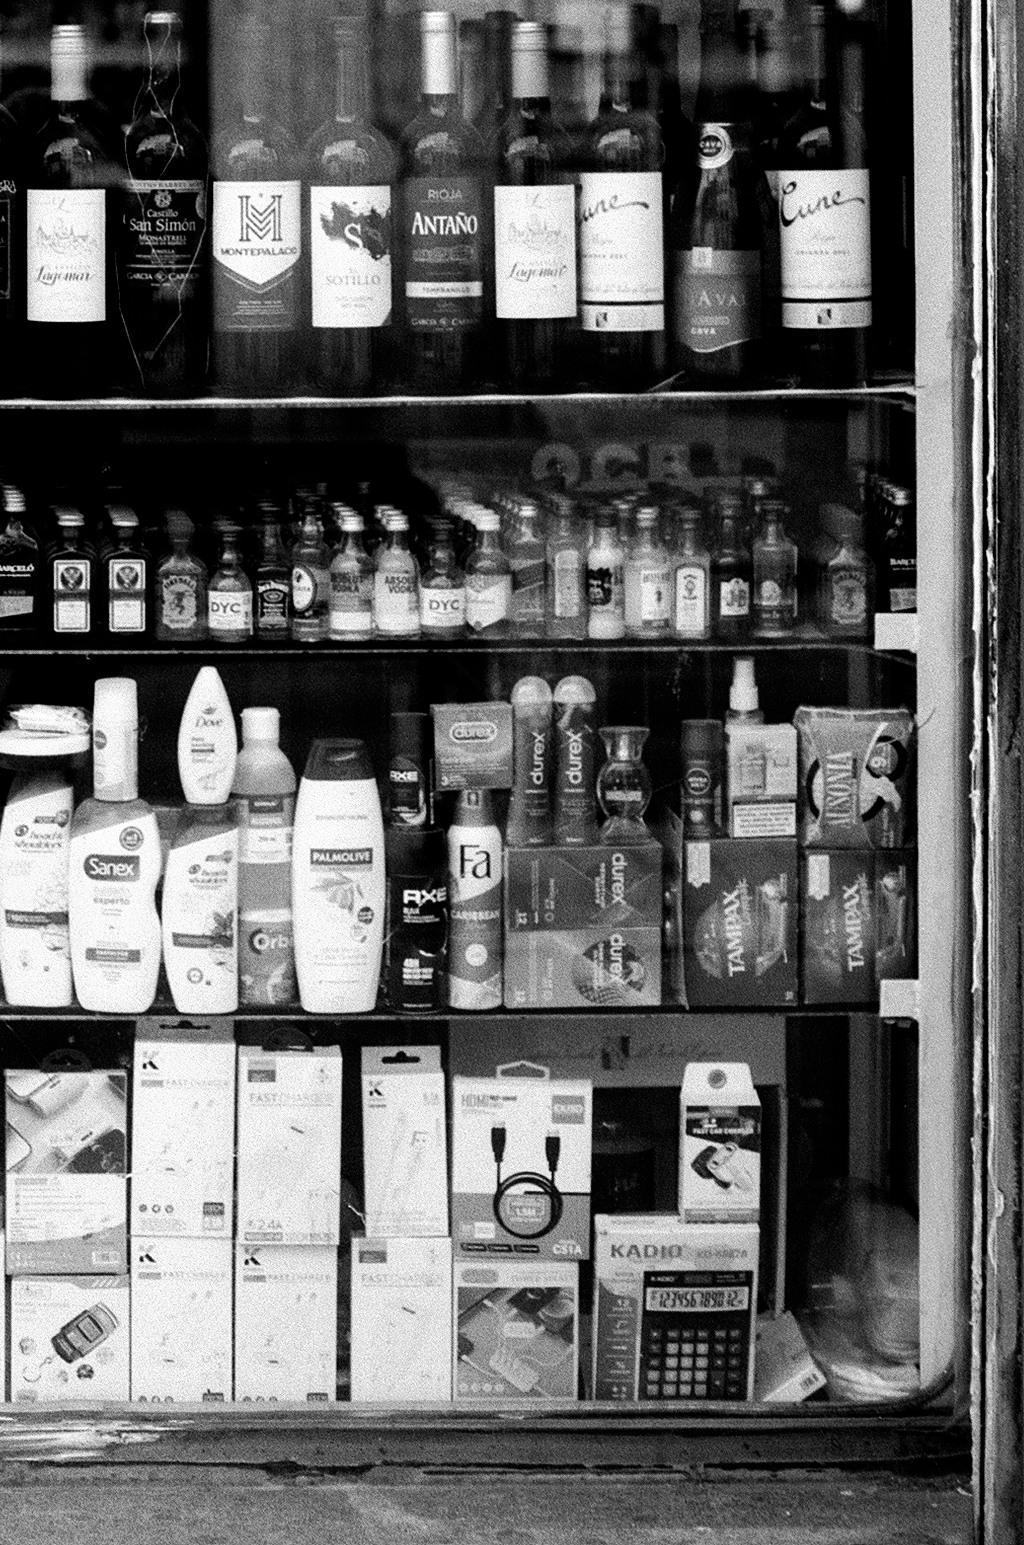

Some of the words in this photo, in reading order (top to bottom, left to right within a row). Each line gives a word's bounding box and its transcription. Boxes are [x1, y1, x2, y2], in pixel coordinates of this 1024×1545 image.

[427, 189, 463, 201] RIOJA
[780, 181, 866, 226] Cune
[146, 208, 179, 218] Castillo
[129, 218, 154, 231] San
[156, 218, 196, 232] Simón
[412, 212, 478, 235] ANTAÑO
[35, 266, 92, 286] Lagomar
[325, 274, 381, 286] SOTILLO
[422, 286, 470, 294] TEMPRANILLO
[690, 327, 716, 335] CAVA
[211, 601, 241, 614] DYC
[429, 598, 460, 611] DYC
[196, 717, 223, 728] Dove
[528, 732, 546, 785] durex
[565, 732, 583, 784] durex
[390, 771, 419, 782] AXE
[826, 750, 852, 828] AUSONIA
[312, 850, 372, 863] PALMOLIVE
[459, 844, 492, 880] Fa
[88, 856, 136, 878] Sanex
[612, 852, 626, 905] durex
[403, 888, 447, 904] AXE
[723, 889, 745, 977] TAMPAX
[843, 884, 865, 972] TAMPAX
[610, 933, 624, 983] durex
[610, 1243, 683, 1259] KADIO
